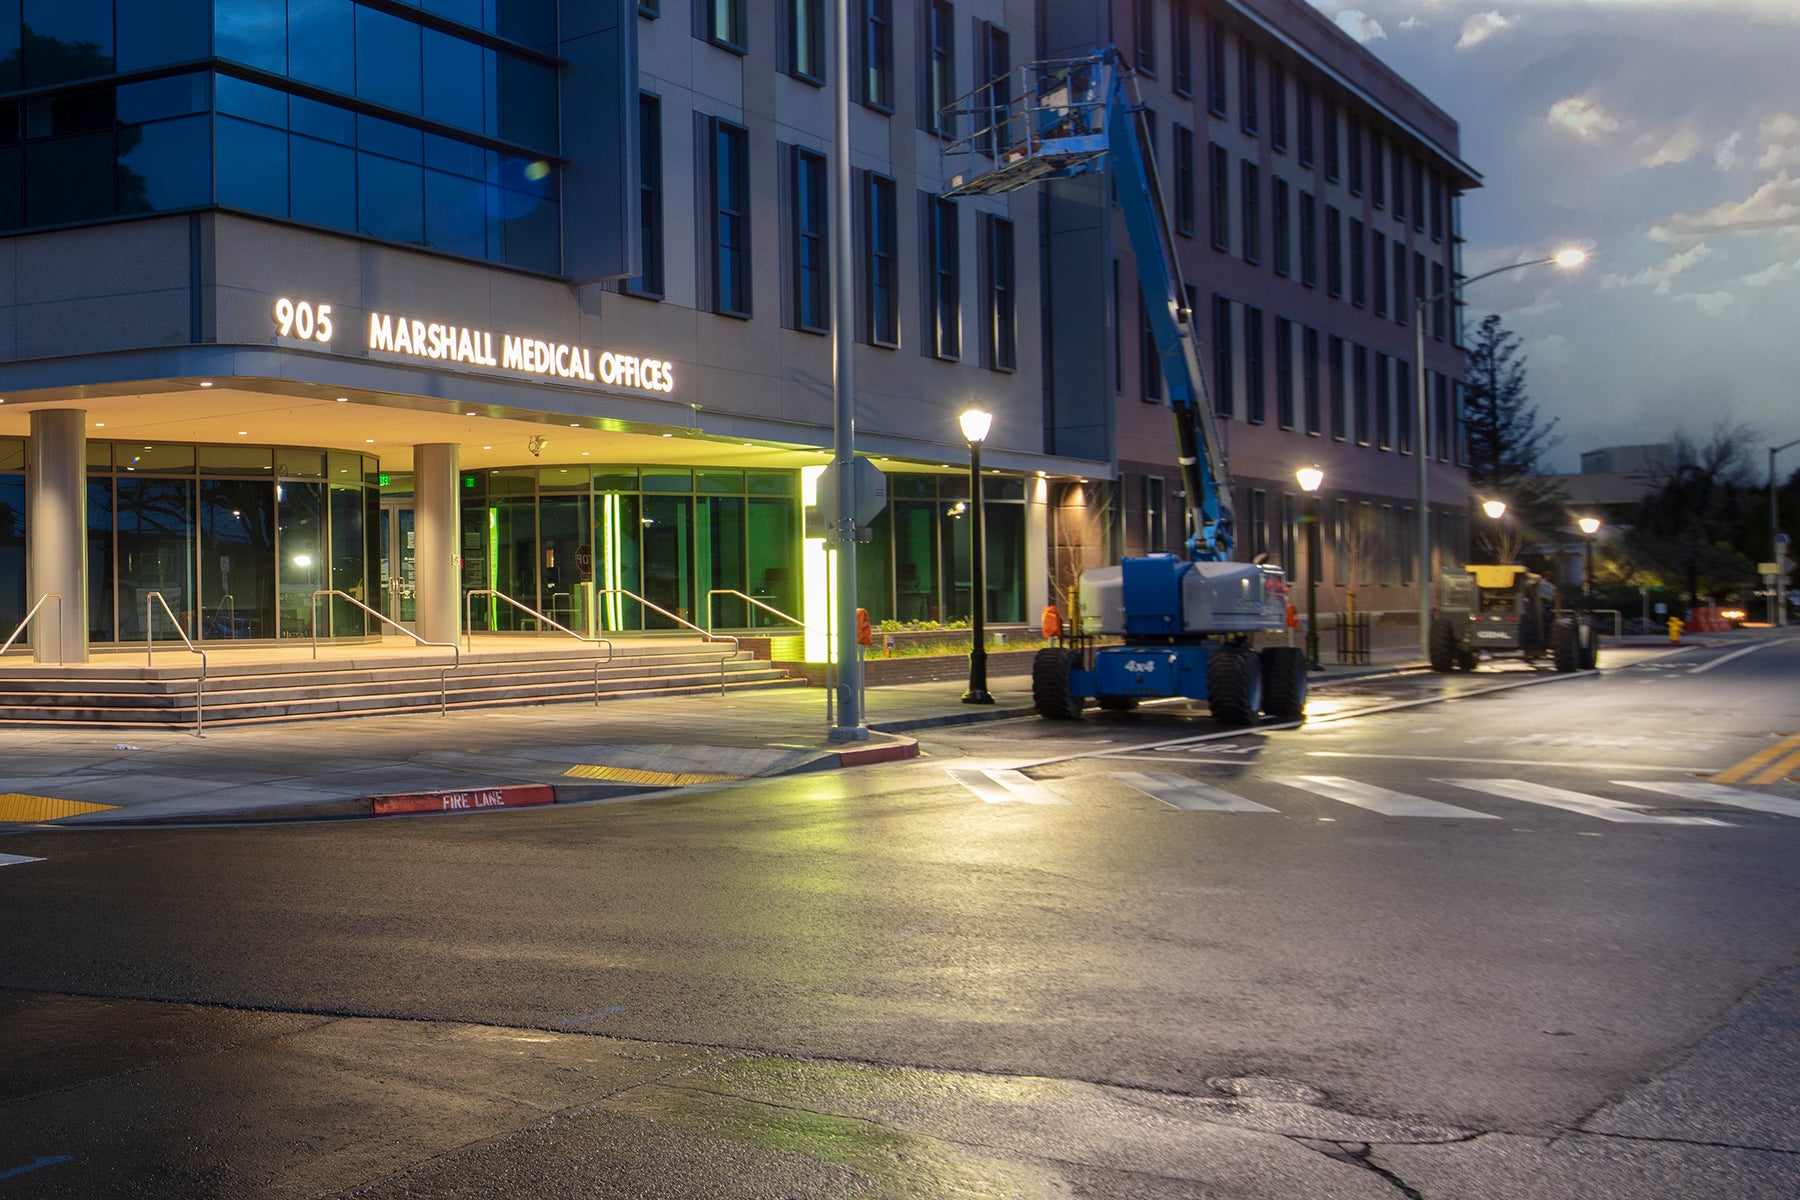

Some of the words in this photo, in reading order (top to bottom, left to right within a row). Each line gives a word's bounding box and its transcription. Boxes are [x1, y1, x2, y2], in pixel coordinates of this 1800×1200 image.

[275, 297, 333, 343] 905
[370, 312, 497, 367] MARSHALL
[503, 335, 595, 381] MEDICAL
[599, 351, 674, 393] OFFICES
[443, 793, 470, 809] FIRE
[475, 790, 504, 807] LANE
